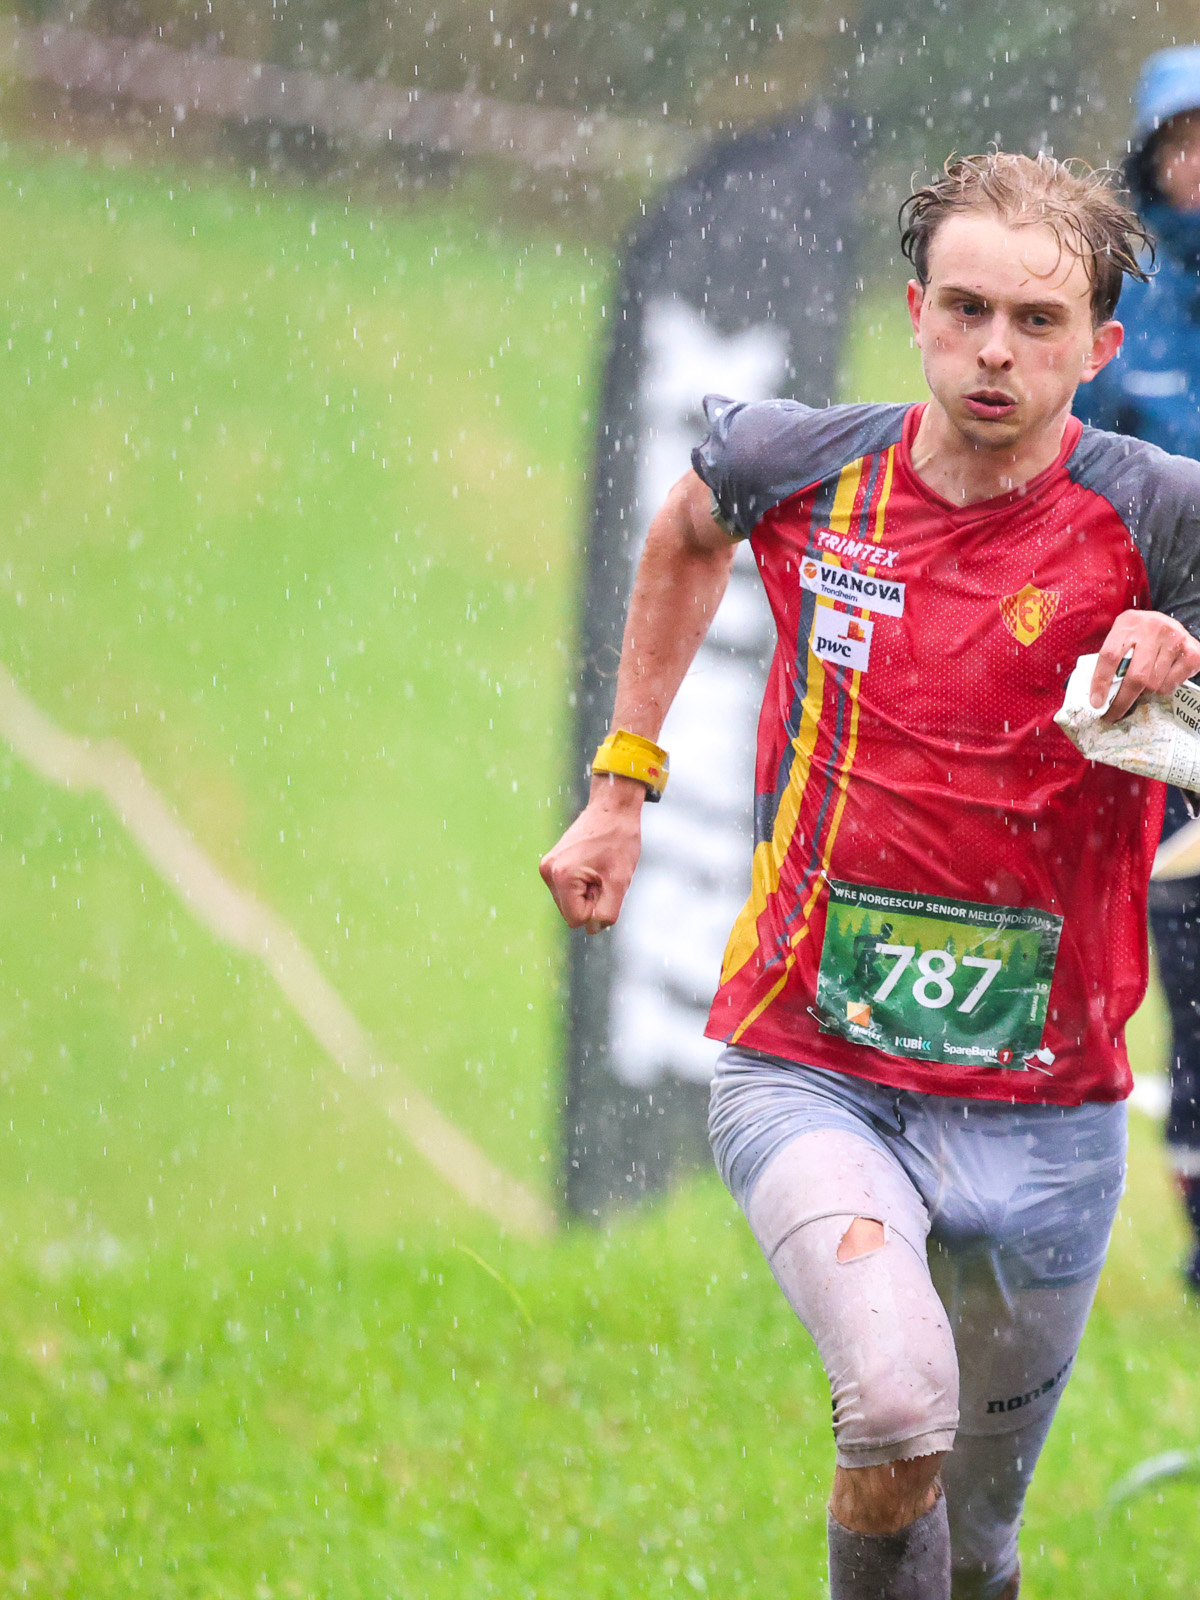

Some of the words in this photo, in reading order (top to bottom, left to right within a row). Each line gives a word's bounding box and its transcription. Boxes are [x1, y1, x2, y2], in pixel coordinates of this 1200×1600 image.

[817, 531, 899, 568] TRIMTEX
[820, 566, 901, 603] VIANOVA
[821, 584, 858, 602] Trondheim
[816, 636, 852, 658] pwc
[835, 883, 857, 899] WRE
[859, 892, 925, 910] NORGESCUP
[925, 902, 967, 918] SENIOR
[872, 942, 1002, 1014] 787
[943, 1042, 998, 1058] SpareBank
